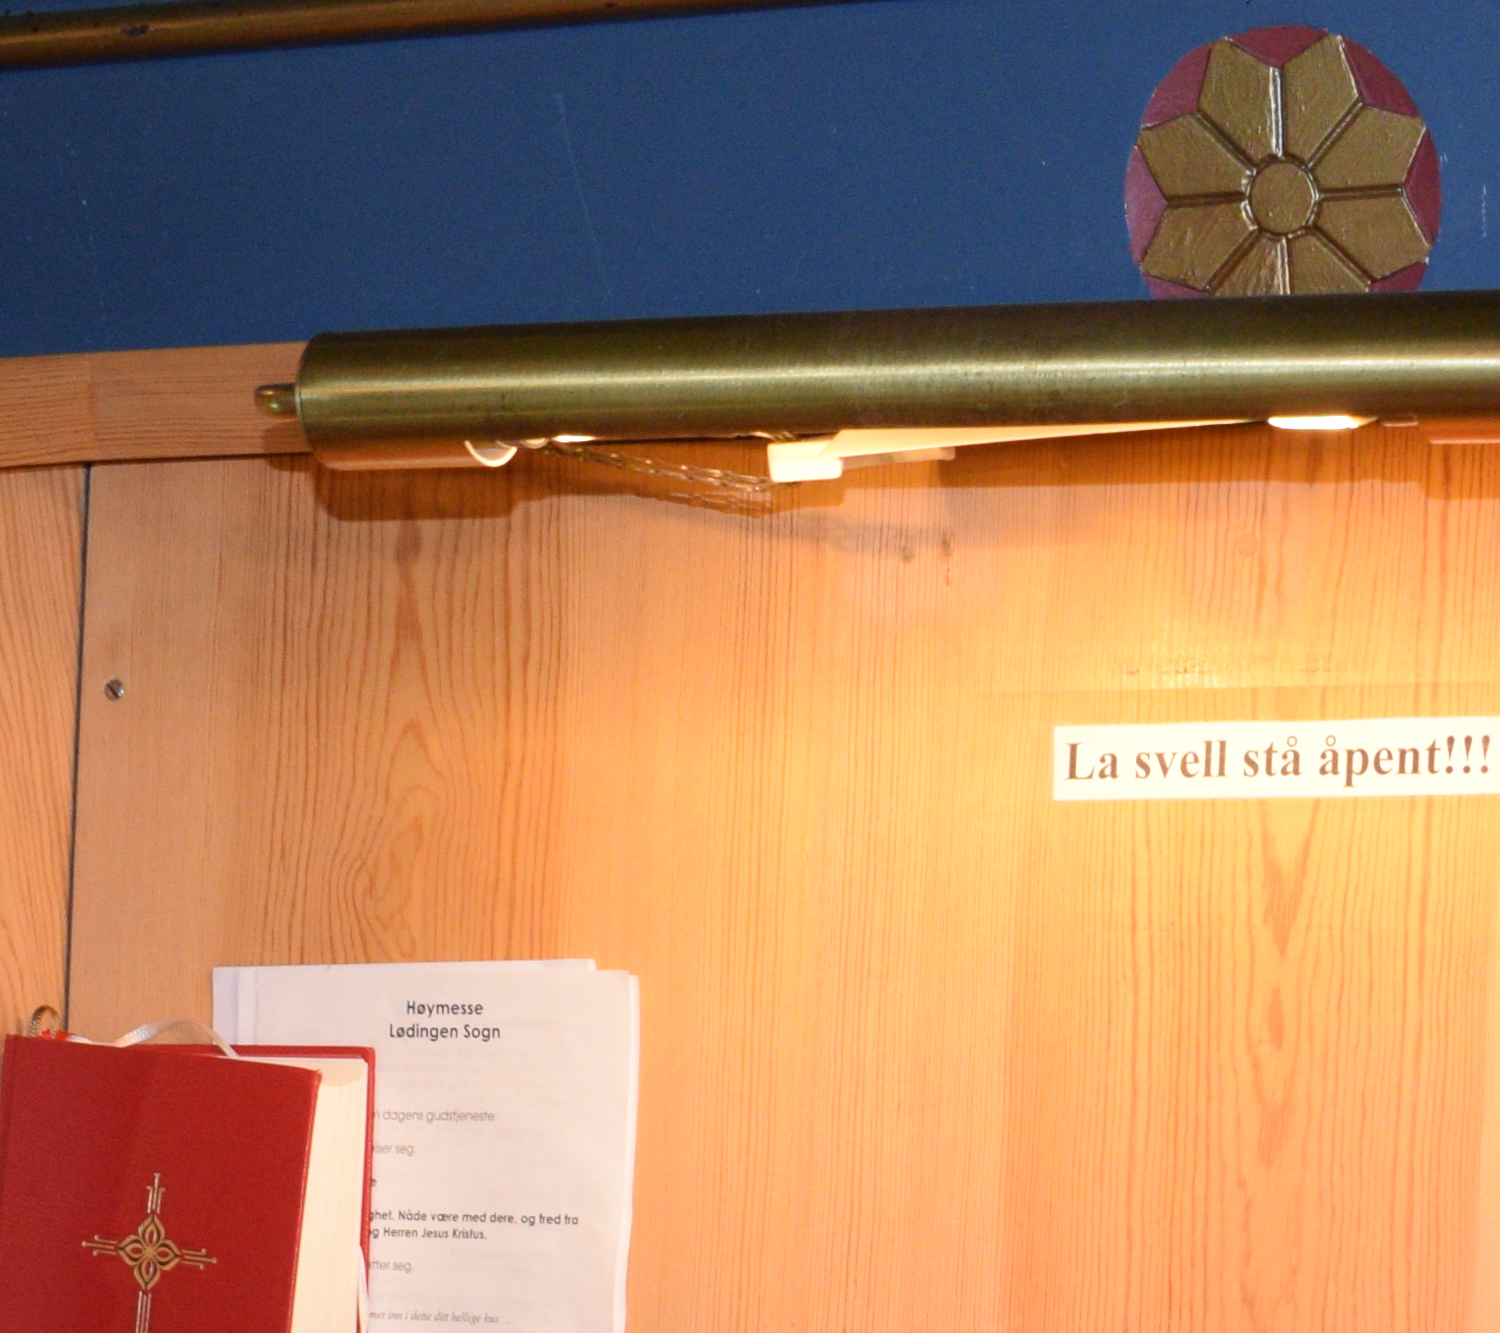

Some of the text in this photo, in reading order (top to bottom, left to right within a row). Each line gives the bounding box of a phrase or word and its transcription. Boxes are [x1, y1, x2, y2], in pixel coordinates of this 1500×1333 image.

[1065, 735, 1491, 788] La svell stå åpent!!!
[406, 1000, 484, 1018] Høymesse
[389, 1023, 501, 1042] Lødingen Sogn
[383, 1110, 423, 1122] dagens
[398, 1210, 426, 1221] Nåde
[431, 1213, 459, 1222] være
[462, 1213, 485, 1222] med
[521, 1215, 535, 1226] og
[539, 1214, 560, 1225] fred
[565, 1216, 578, 1225] fra
[384, 1227, 418, 1238] Herren
[421, 1228, 449, 1239] Jesus
[452, 1229, 487, 1240] Kristus.
